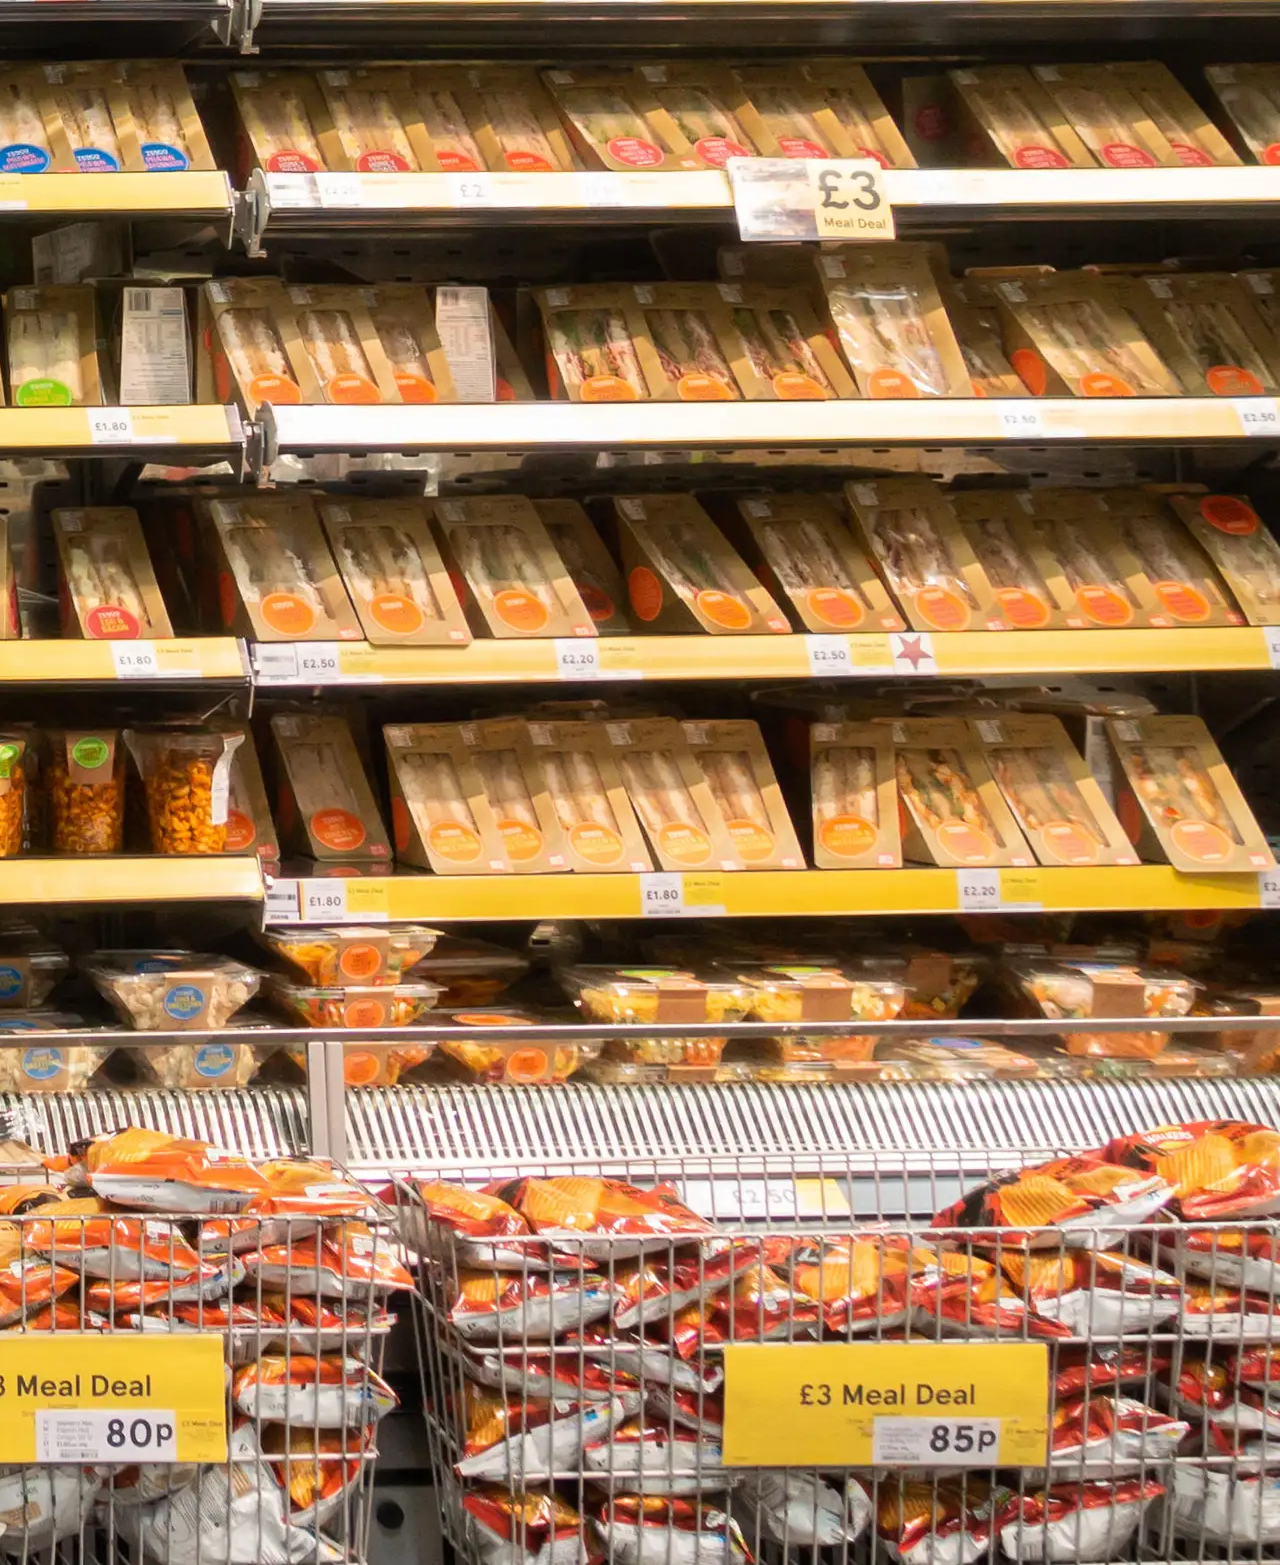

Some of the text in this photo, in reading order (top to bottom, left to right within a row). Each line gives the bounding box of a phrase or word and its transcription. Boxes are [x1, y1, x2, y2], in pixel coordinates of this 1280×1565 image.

[460, 183, 486, 198] £2
[819, 170, 881, 210] £3
[824, 216, 887, 230] Meal Deal
[119, 655, 151, 666] £1.80
[562, 654, 595, 665] £2.20
[813, 650, 846, 661] £2.50
[303, 658, 336, 669] £2.50
[646, 889, 678, 900] £1.80
[963, 885, 996, 897] £2.20
[309, 895, 342, 907] £1.80
[17, 1375, 81, 1397] Meal
[92, 1374, 152, 1397] Deal
[800, 1383, 976, 1406] £3 Meal Deal
[107, 1418, 173, 1448] 80p
[929, 1425, 997, 1452] 85p
